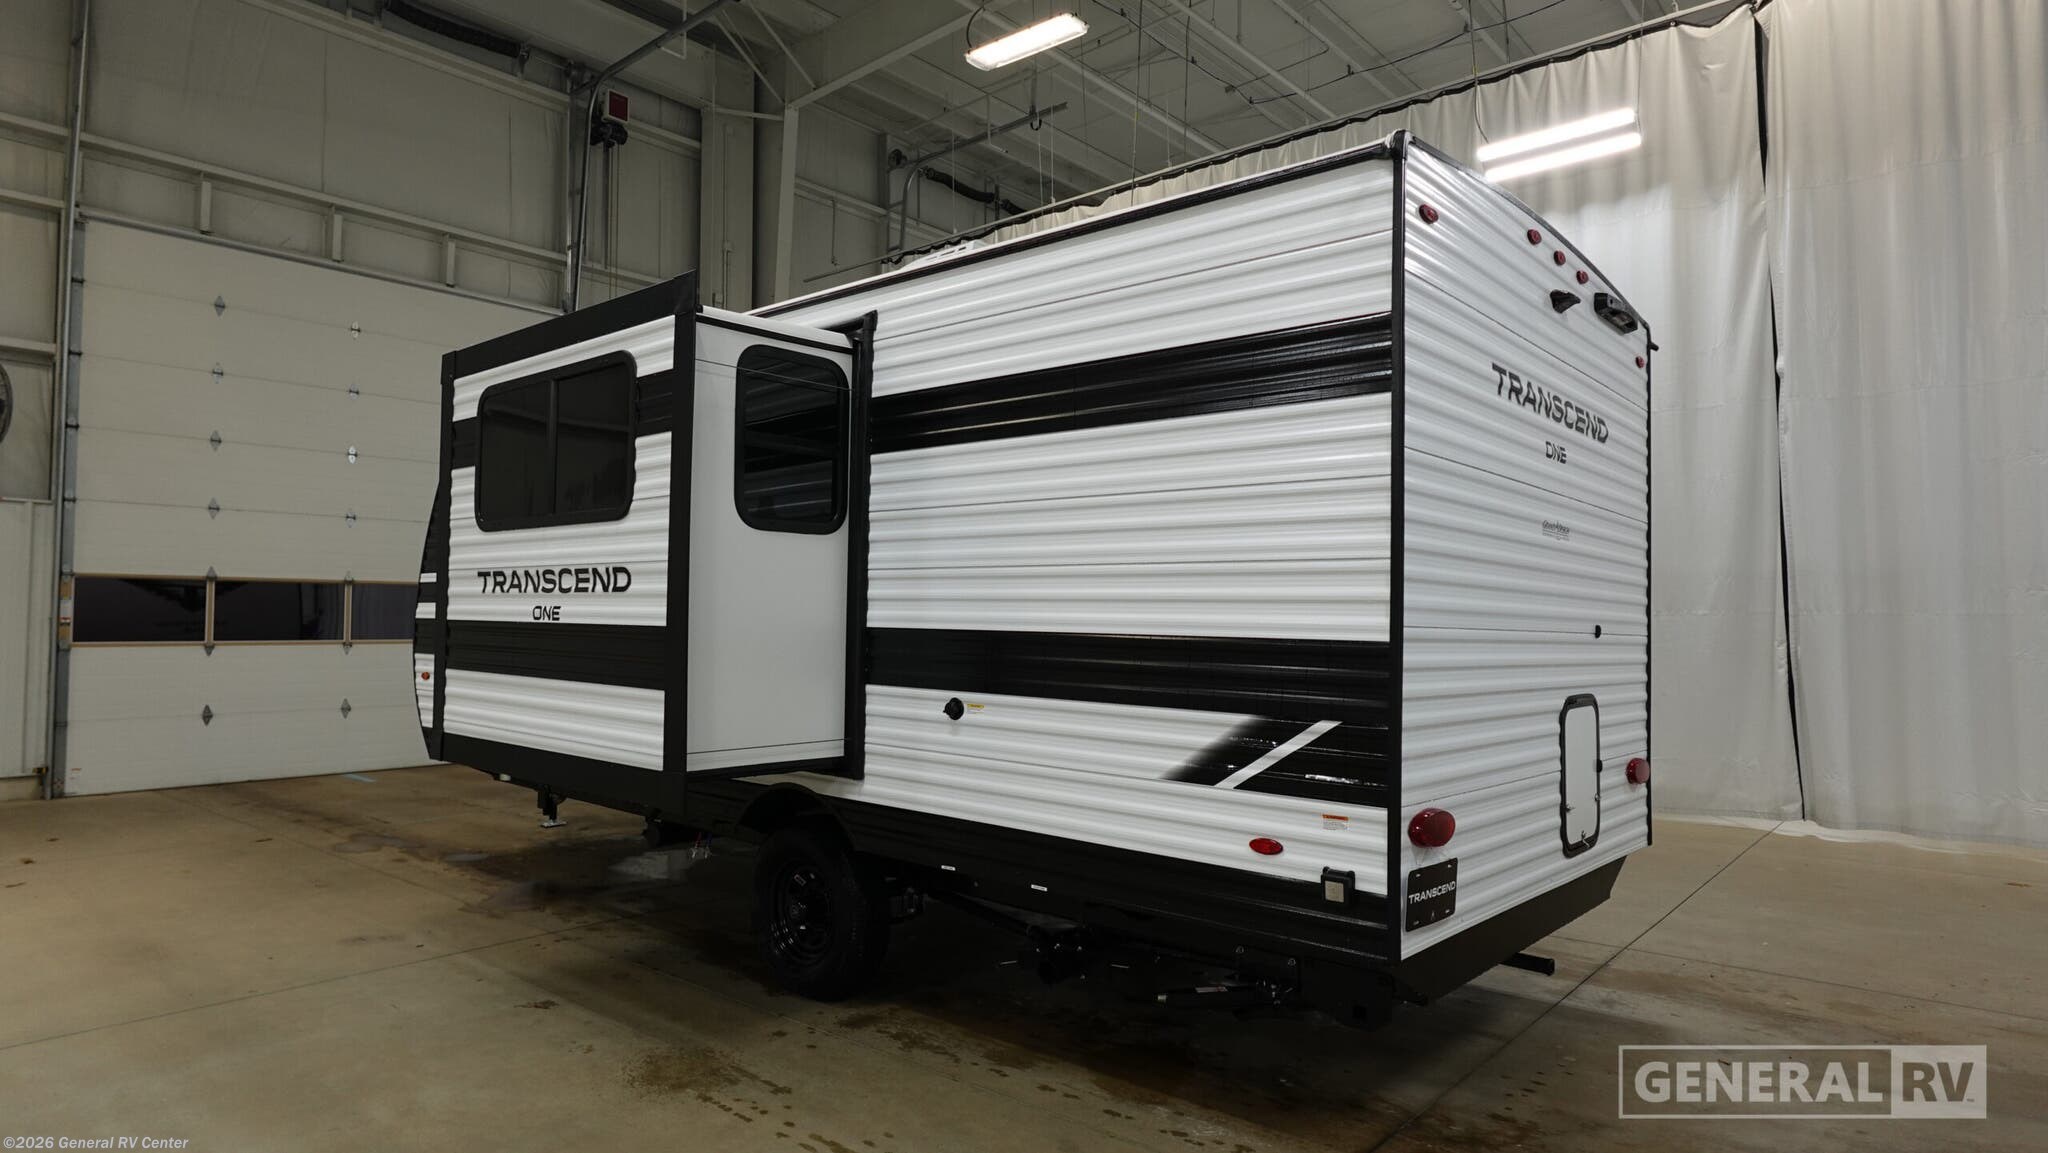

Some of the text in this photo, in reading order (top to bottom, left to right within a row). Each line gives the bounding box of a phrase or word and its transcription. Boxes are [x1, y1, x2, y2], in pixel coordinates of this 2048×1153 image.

[1492, 362, 1609, 443] TRANSCEND
[1545, 441, 1567, 464] ONE
[477, 566, 632, 594] TRANSCEND
[532, 605, 561, 621] ONE
[1408, 880, 1457, 904] TRANSCEND
